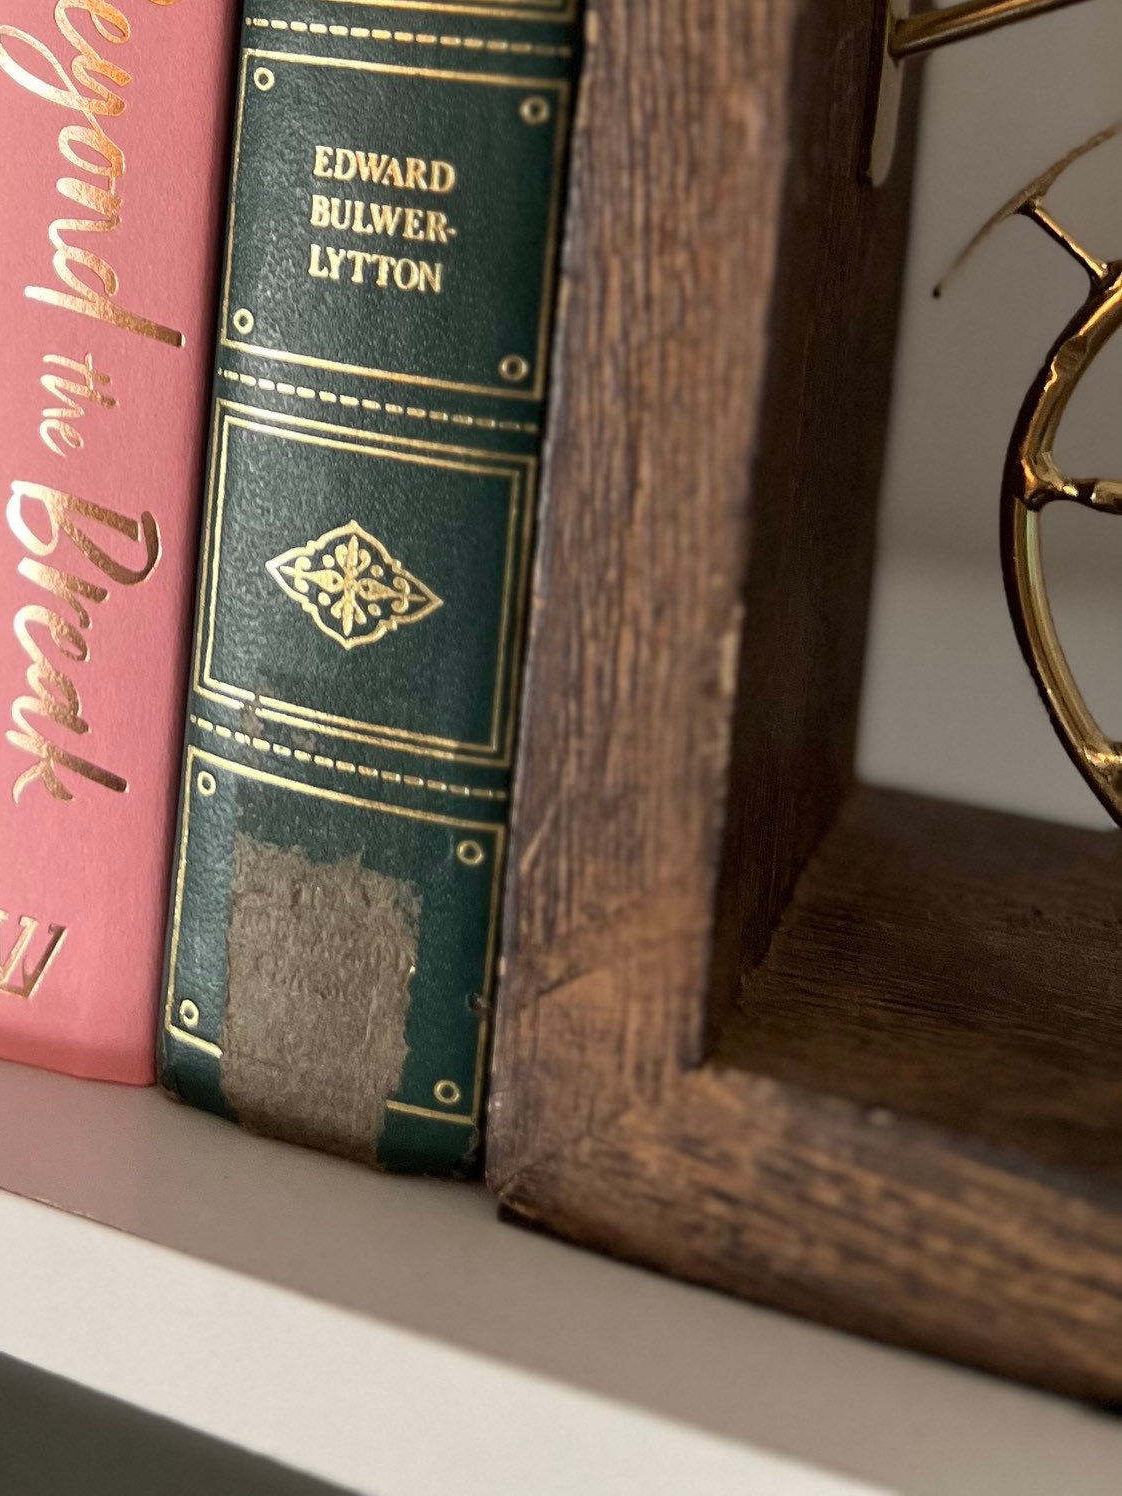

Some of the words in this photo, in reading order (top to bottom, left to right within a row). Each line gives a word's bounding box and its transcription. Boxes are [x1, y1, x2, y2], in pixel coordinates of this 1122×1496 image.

[313, 145, 455, 193] EDWARD
[310, 194, 457, 243] BULWER-
[308, 244, 442, 293] LYTTON
[39, 352, 119, 456] the
[5, 480, 163, 804] Break
